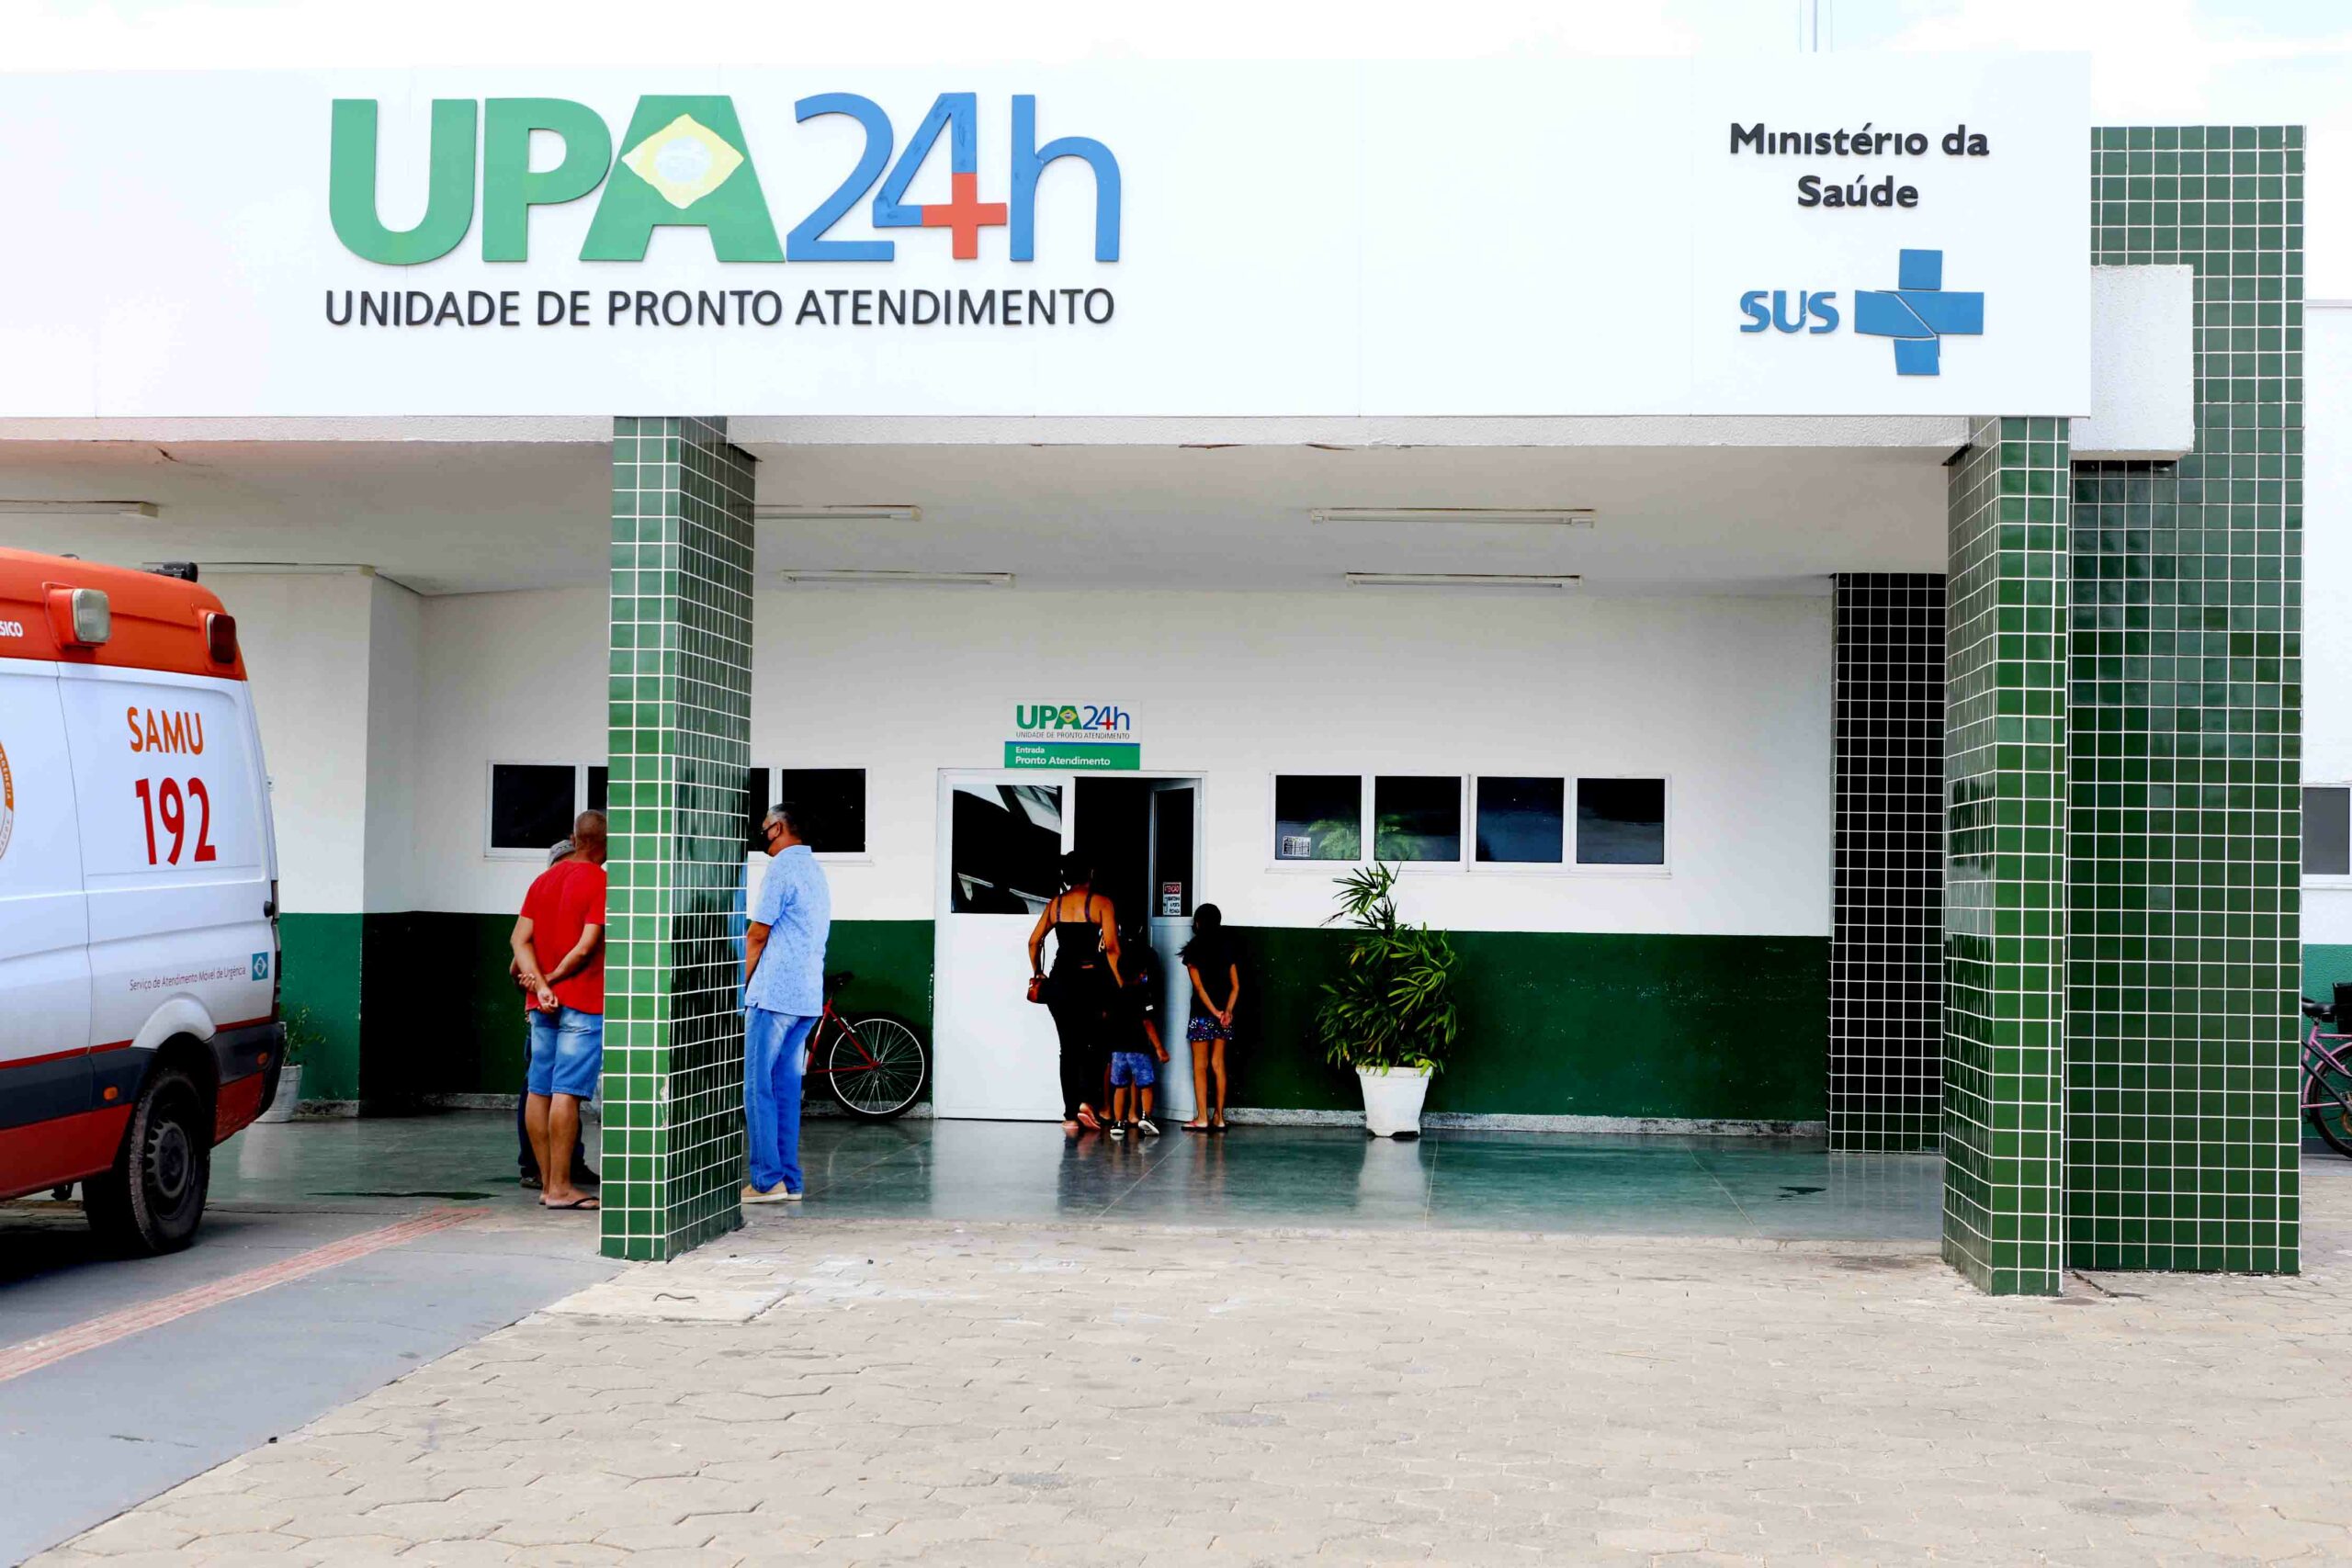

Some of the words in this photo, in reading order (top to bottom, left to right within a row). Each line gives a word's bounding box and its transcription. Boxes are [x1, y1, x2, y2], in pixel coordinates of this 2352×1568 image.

[1730, 122, 1928, 156] Ministério
[1941, 124, 1990, 156] da
[1797, 174, 1919, 209] Saúde
[325, 289, 520, 327] UNIDADE
[537, 290, 591, 327] DE
[608, 289, 783, 327] PRONTO
[795, 288, 1115, 327] ATENDIMENTO
[1739, 289, 1840, 334] SUS
[127, 706, 204, 755] SAMU
[1057, 731, 1083, 739] PRONTO
[1083, 732, 1130, 740] ATENDIMENTO
[1015, 746, 1046, 754] Entrada
[1015, 756, 1046, 765] Pronto
[1048, 756, 1111, 766] Atendimento
[135, 777, 217, 866] 192
[130, 978, 152, 992] Serviço
[153, 976, 161, 989] de
[161, 973, 198, 987] Atendimento
[216, 967, 223, 979] de
[224, 965, 246, 981] Urgência
